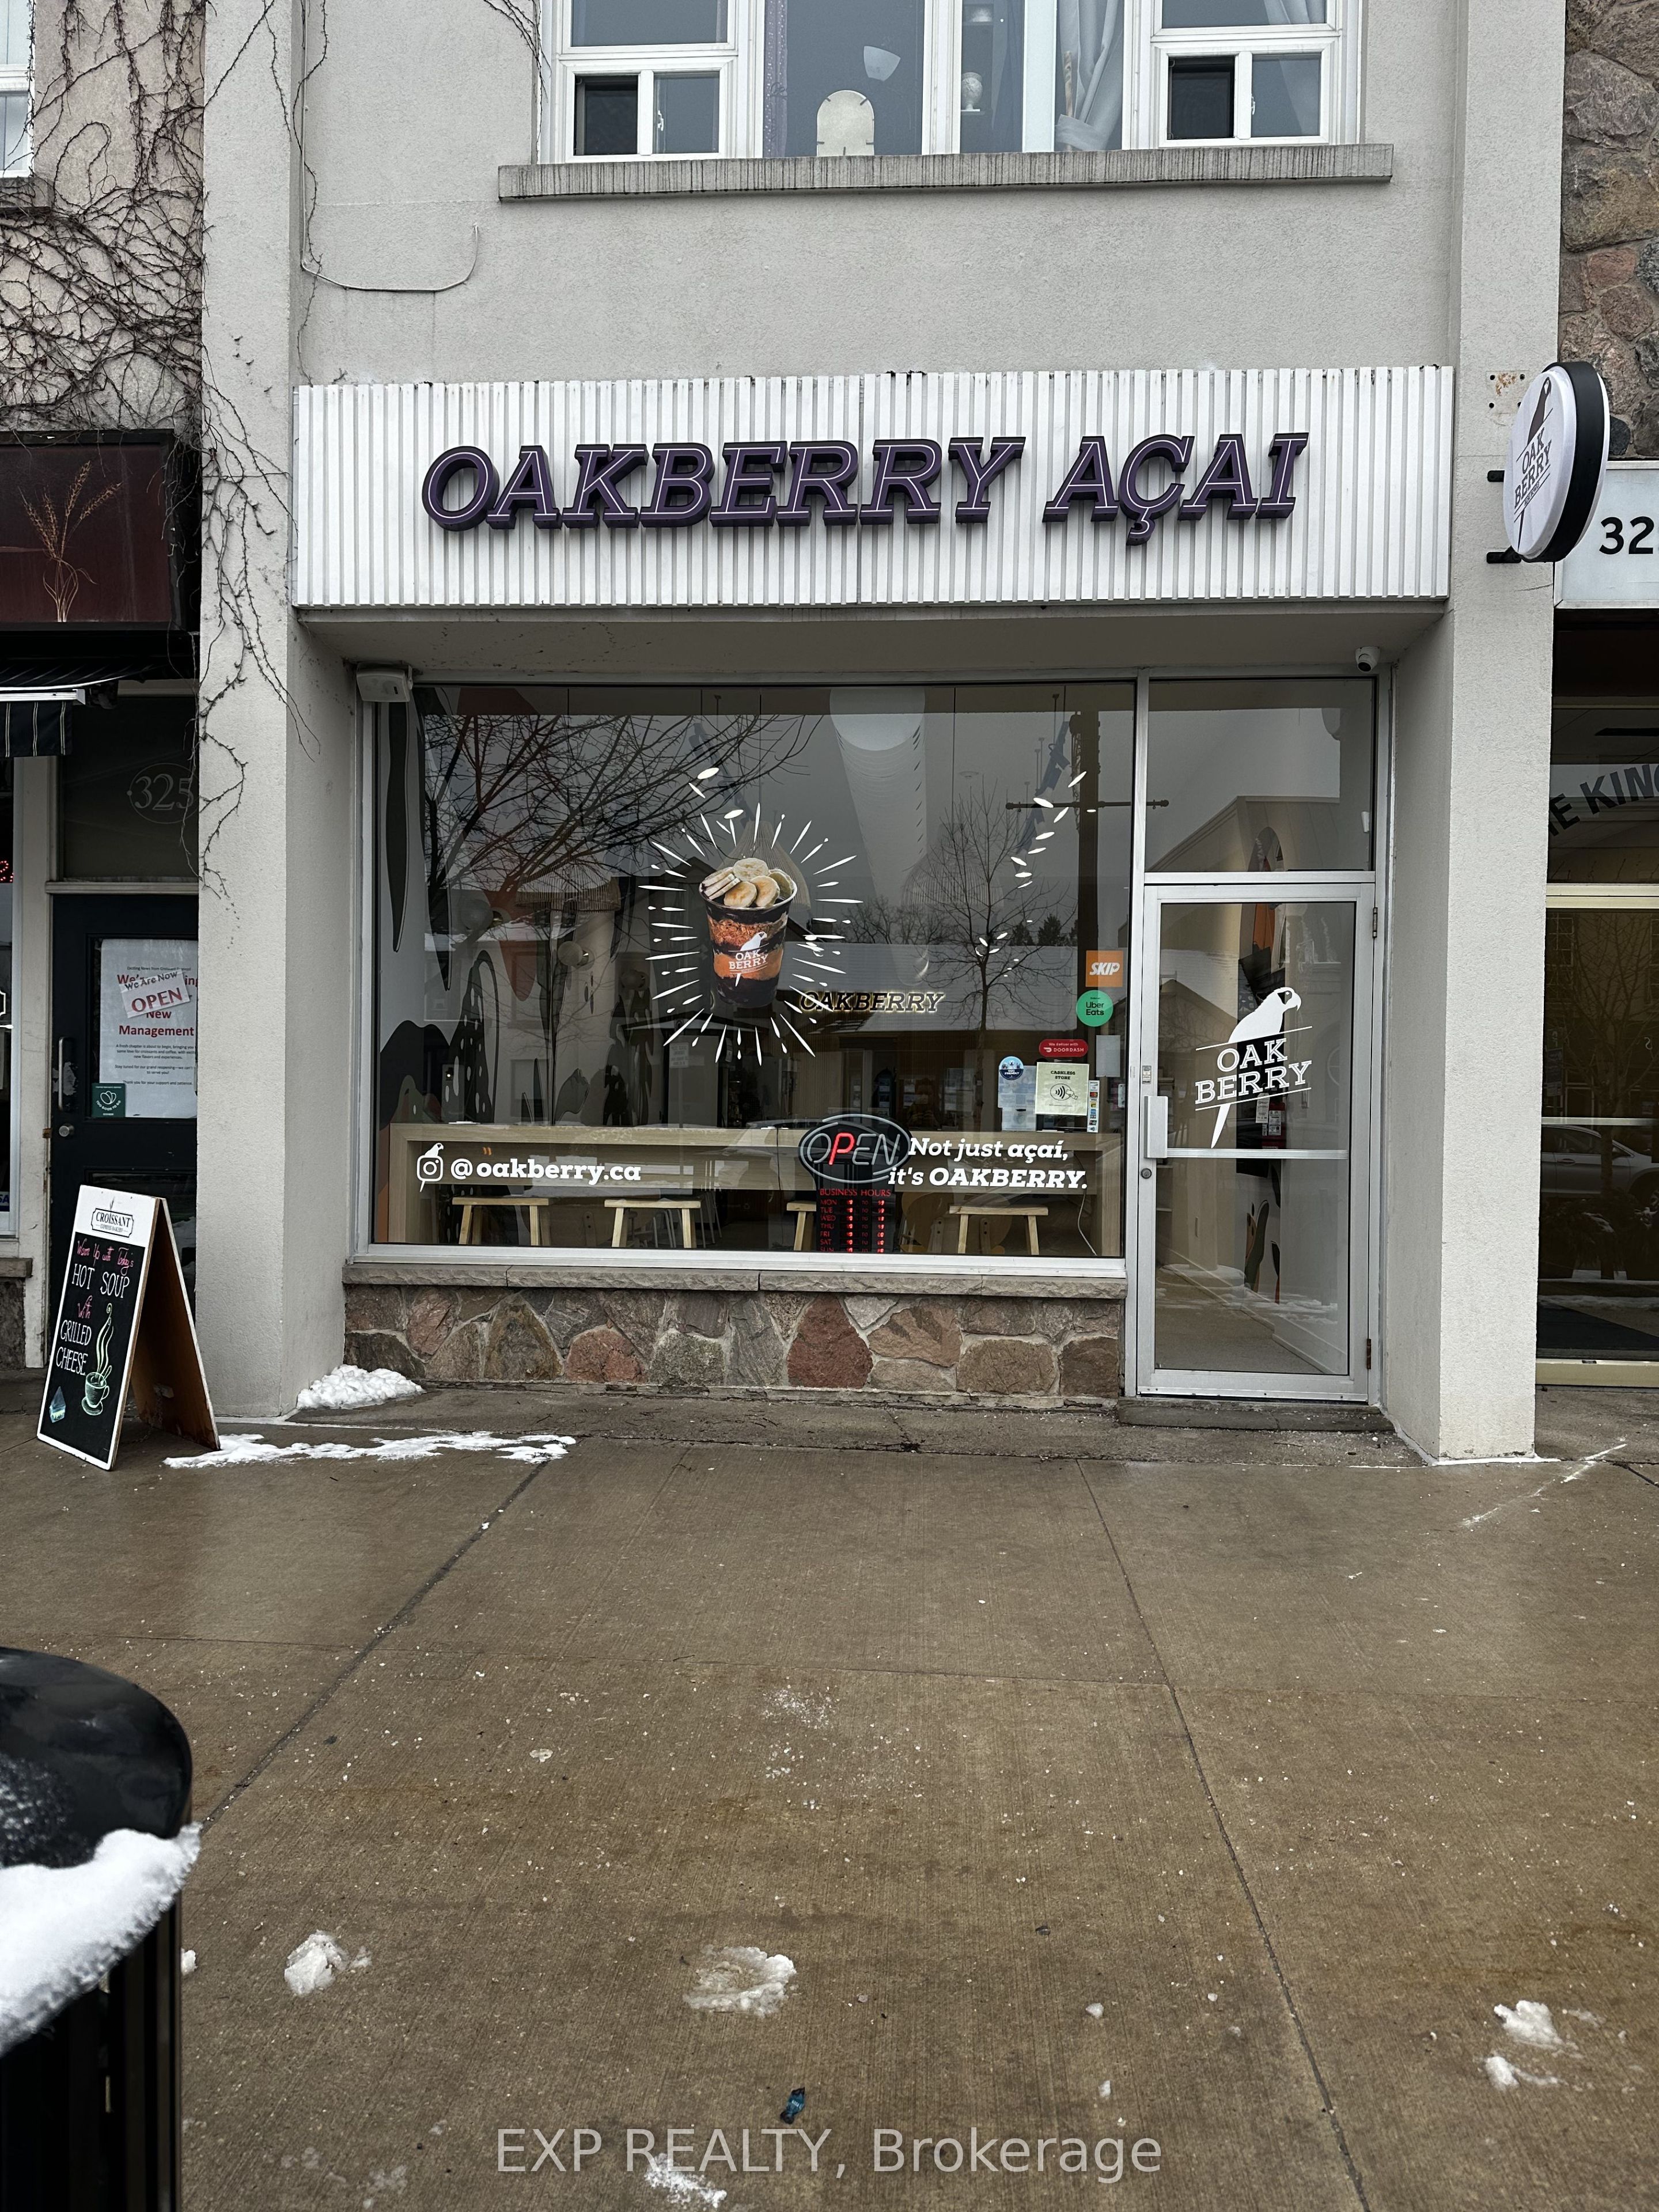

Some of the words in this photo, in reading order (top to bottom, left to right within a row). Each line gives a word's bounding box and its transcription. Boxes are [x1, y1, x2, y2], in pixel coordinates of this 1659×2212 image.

[1522, 427, 1544, 474] OAK
[1514, 439, 1552, 509] BERRY
[422, 437, 1026, 531] OAKBERRY
[1042, 433, 1309, 546] AÇAI
[135, 774, 194, 810] 325
[1580, 764, 1659, 815] KIN
[729, 953, 768, 969] BERRY
[736, 949, 761, 961] OAK
[125, 982, 139, 990] We
[141, 977, 157, 986] Are
[157, 971, 178, 982] Now
[1089, 962, 1120, 975] SKIP
[131, 987, 183, 1012] OPEN
[800, 991, 945, 1012] OAKBERRY
[119, 1025, 195, 1037] Management
[1217, 1037, 1288, 1072] OAK
[1195, 1060, 1312, 1104] BERRY
[806, 1132, 900, 1165] OPEN
[908, 1137, 952, 1156] Not
[953, 1138, 1003, 1162] just
[1007, 1140, 1068, 1163] açaí,
[888, 1167, 924, 1186] it's
[929, 1167, 1088, 1189] OAKBERRY.
[861, 1189, 891, 1197] HOURS
[96, 1211, 131, 1227] CROISSANT
[77, 1238, 90, 1256] Warm
[93, 1243, 100, 1266] Up
[72, 1263, 95, 1289] HOT
[100, 1271, 130, 1298] SOUP
[60, 1320, 92, 1346] GRILLED
[56, 1346, 88, 1376] CHEESE
